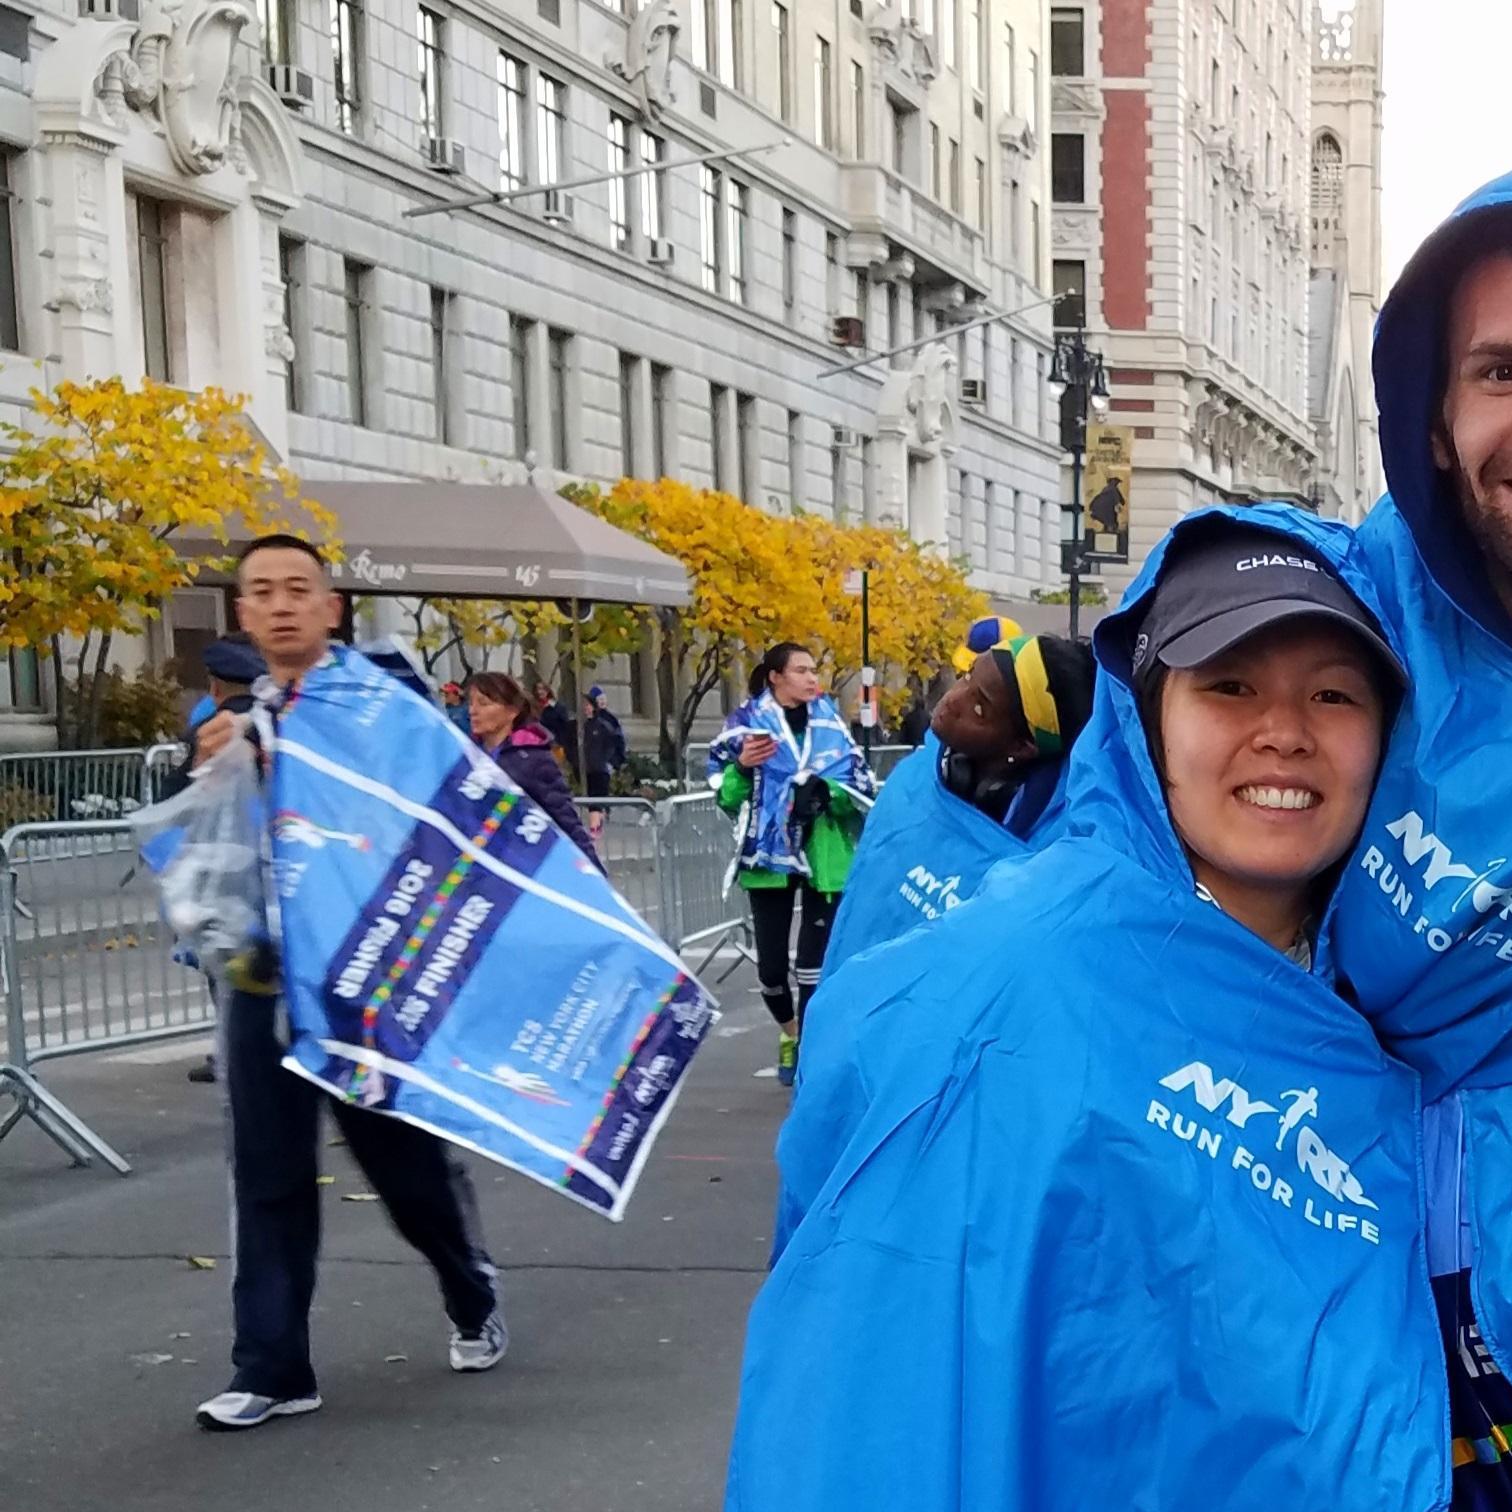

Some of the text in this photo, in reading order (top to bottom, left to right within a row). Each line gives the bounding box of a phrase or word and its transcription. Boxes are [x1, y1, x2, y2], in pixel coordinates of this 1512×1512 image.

[515, 563, 540, 588] 145
[1236, 554, 1319, 572] CHASE
[922, 902, 941, 920] FO
[1360, 845, 1413, 916] RUN
[1414, 916, 1453, 952] FO
[413, 895, 495, 998] FINISHER
[510, 1019, 543, 1052] TCS
[1146, 1099, 1380, 1245] RUN FOR LIFE
